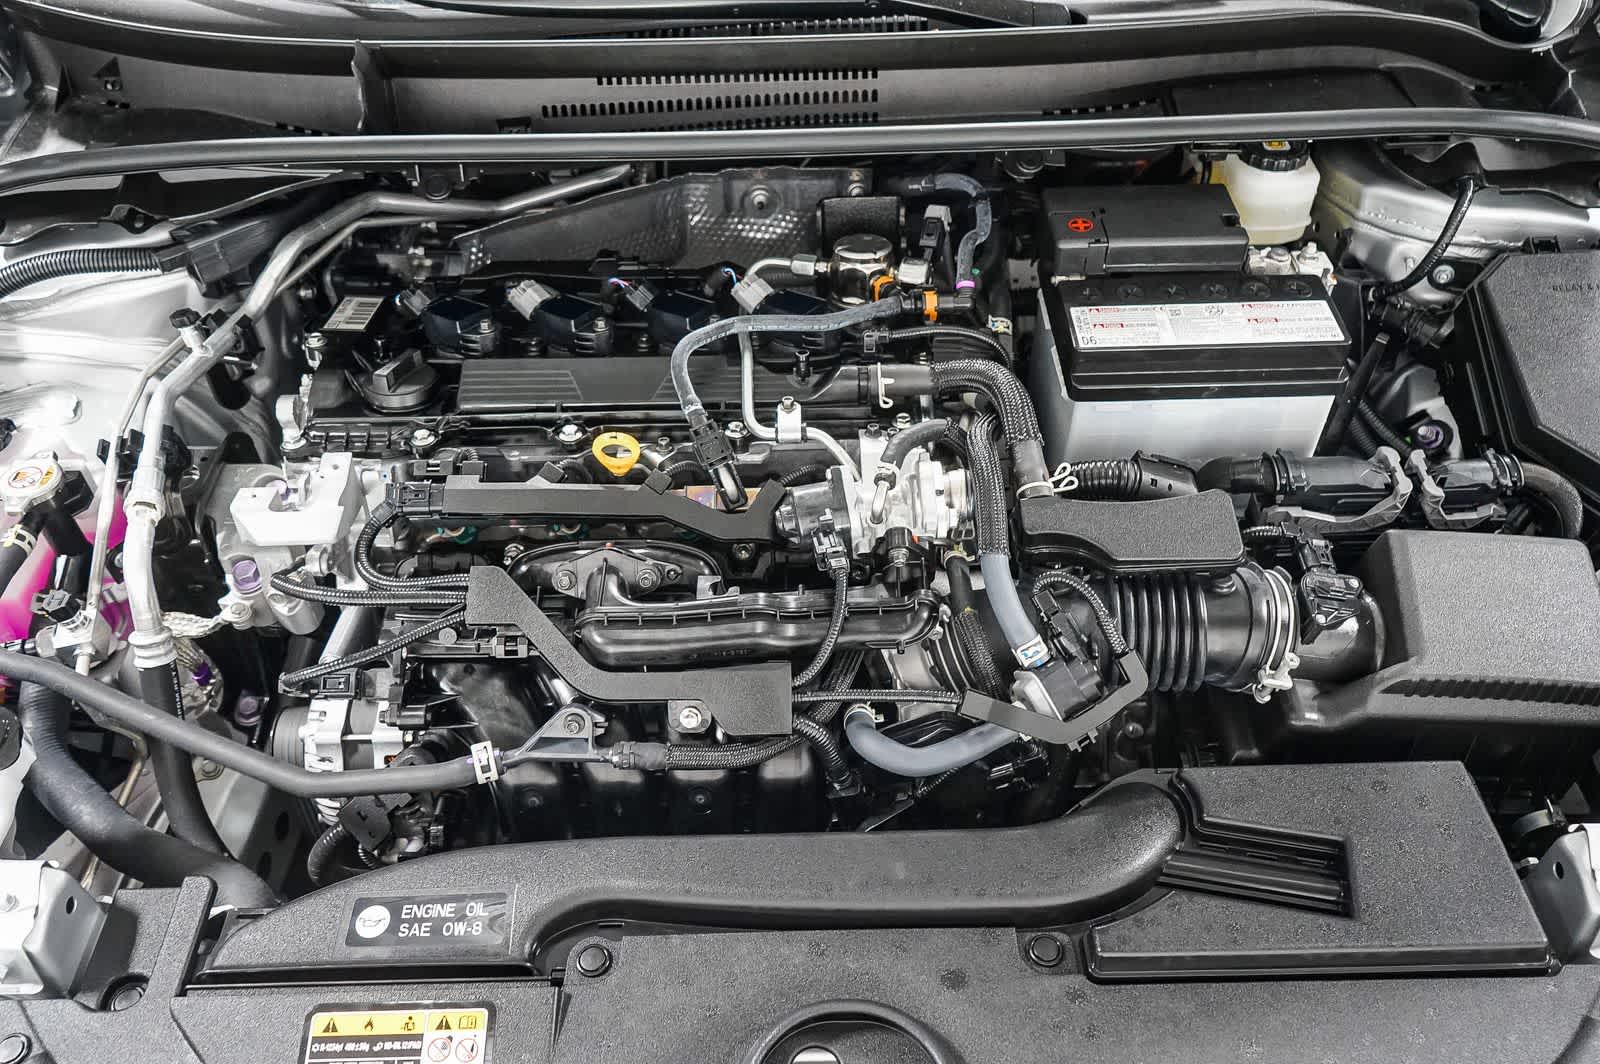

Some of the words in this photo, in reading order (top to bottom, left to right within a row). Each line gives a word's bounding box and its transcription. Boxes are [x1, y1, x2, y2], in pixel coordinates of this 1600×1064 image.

[401, 902, 456, 919] ENGINE
[466, 902, 489, 917] OIL
[399, 922, 432, 938] SAE
[442, 921, 482, 937] 0W-8
